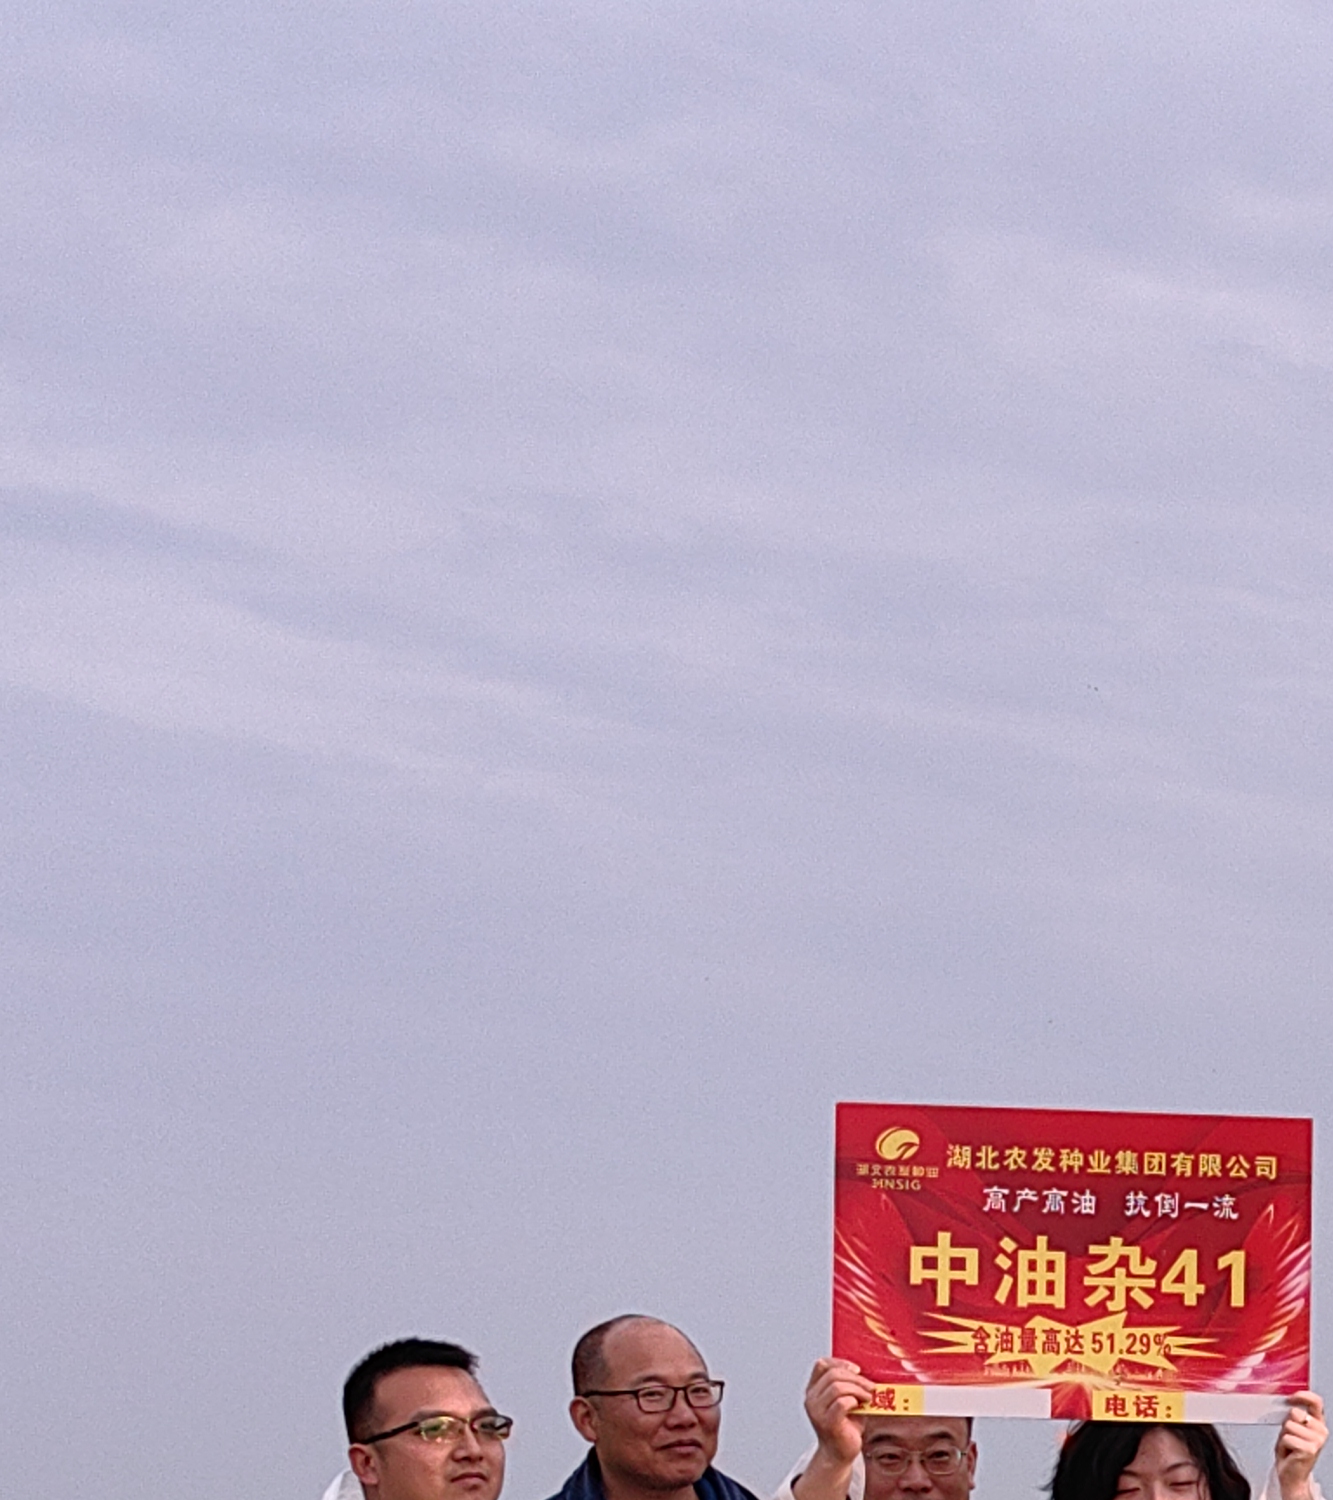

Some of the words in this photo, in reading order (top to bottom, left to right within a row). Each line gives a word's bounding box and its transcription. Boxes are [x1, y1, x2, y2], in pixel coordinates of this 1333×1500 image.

[947, 1144, 1279, 1181] 湖北农发种业集团有限公司
[982, 1186, 1097, 1217] 高产高油
[1124, 1191, 1240, 1220] 抗倒一流
[908, 1230, 1246, 1311] 中油杂41
[1104, 1394, 1173, 1420] 电话：
